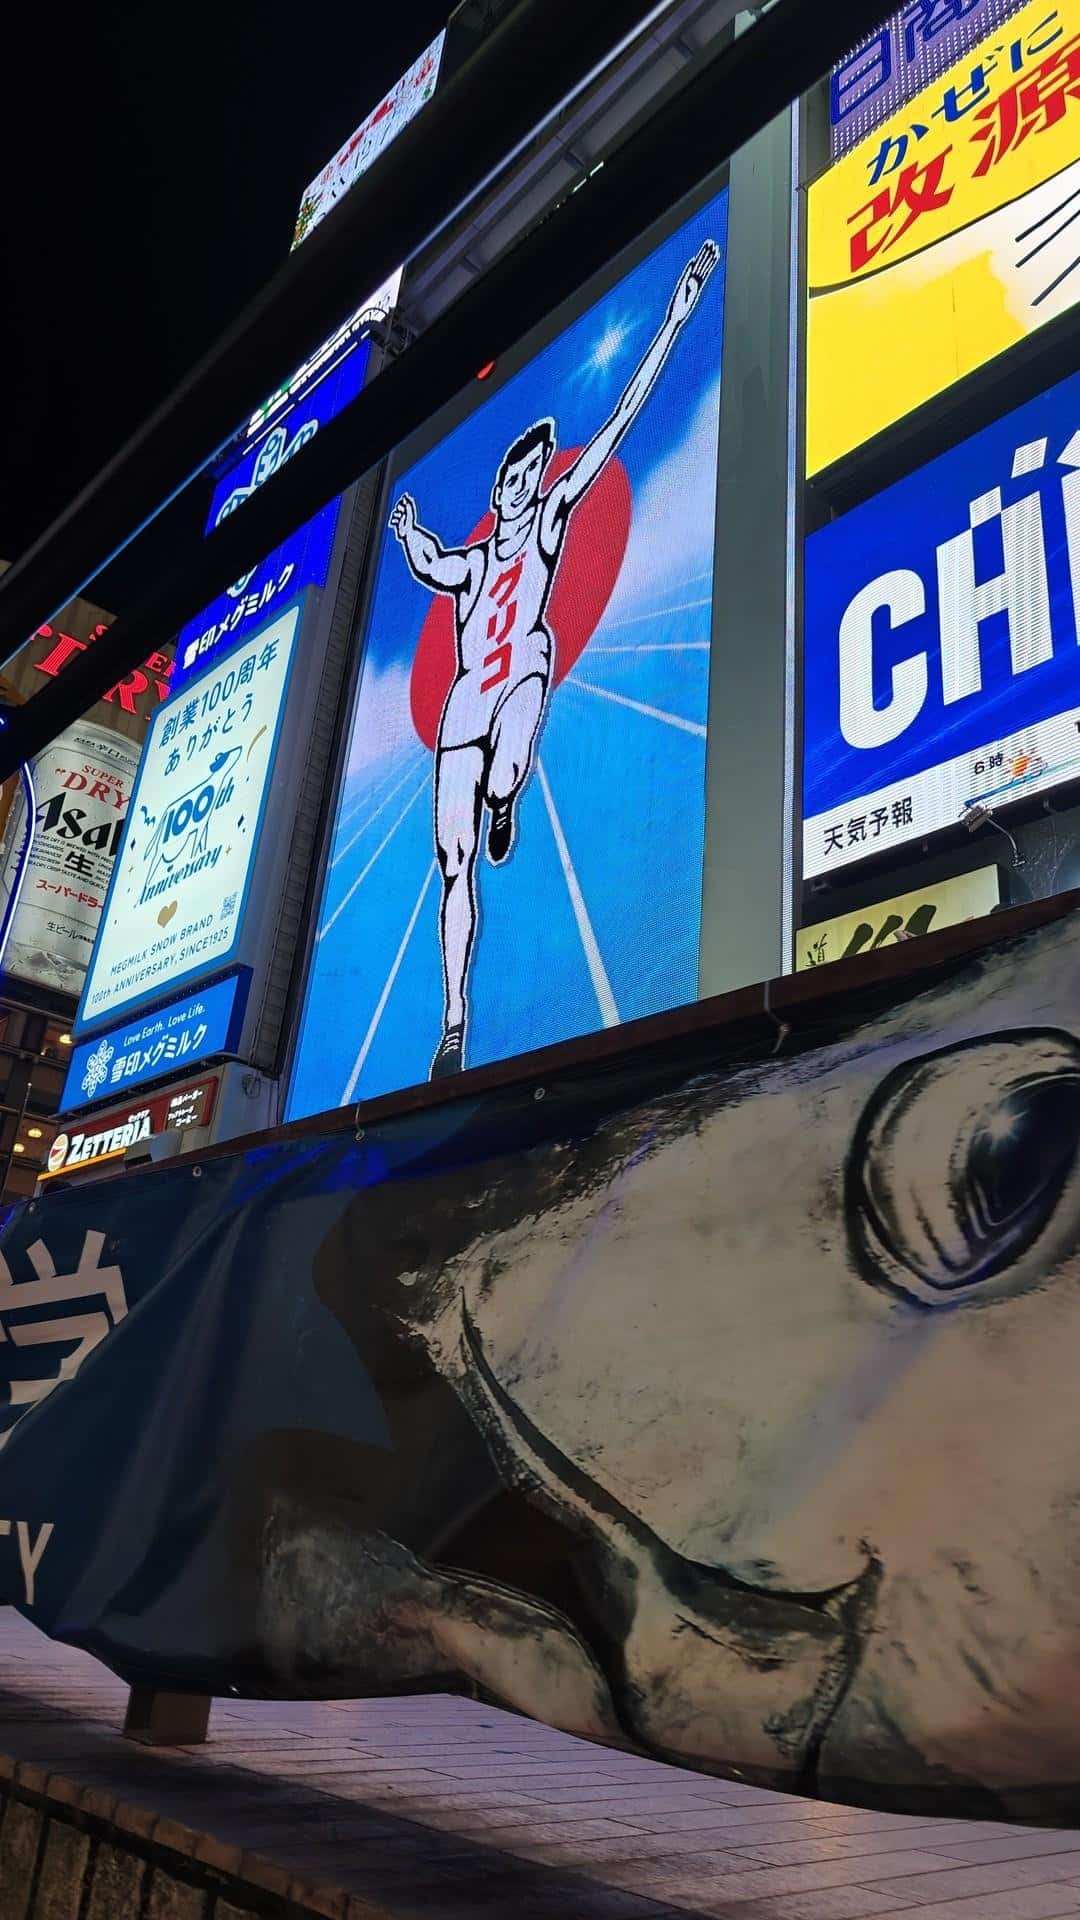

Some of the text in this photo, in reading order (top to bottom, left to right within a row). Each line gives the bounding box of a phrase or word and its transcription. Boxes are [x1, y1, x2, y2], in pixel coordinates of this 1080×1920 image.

[866, 10, 1064, 187] かぜに
[847, 34, 1080, 273] 改源
[480, 551, 527, 695] グリコ
[158, 638, 280, 749] 創業100周年
[164, 692, 254, 776] ありがとう
[81, 764, 125, 789] SUPER
[824, 797, 913, 856] 天気予報
[36, 879, 104, 909] スーパードラ
[64, 851, 95, 878] 生
[110, 914, 213, 977] MEGMILK SNOW BRAND
[110, 1023, 208, 1084] 雪印メグミルク
[123, 1033, 139, 1047] Love
[168, 1011, 185, 1029] Love
[187, 1002, 206, 1019] Life.
[65, 1116, 151, 1167] ZETTERIA
